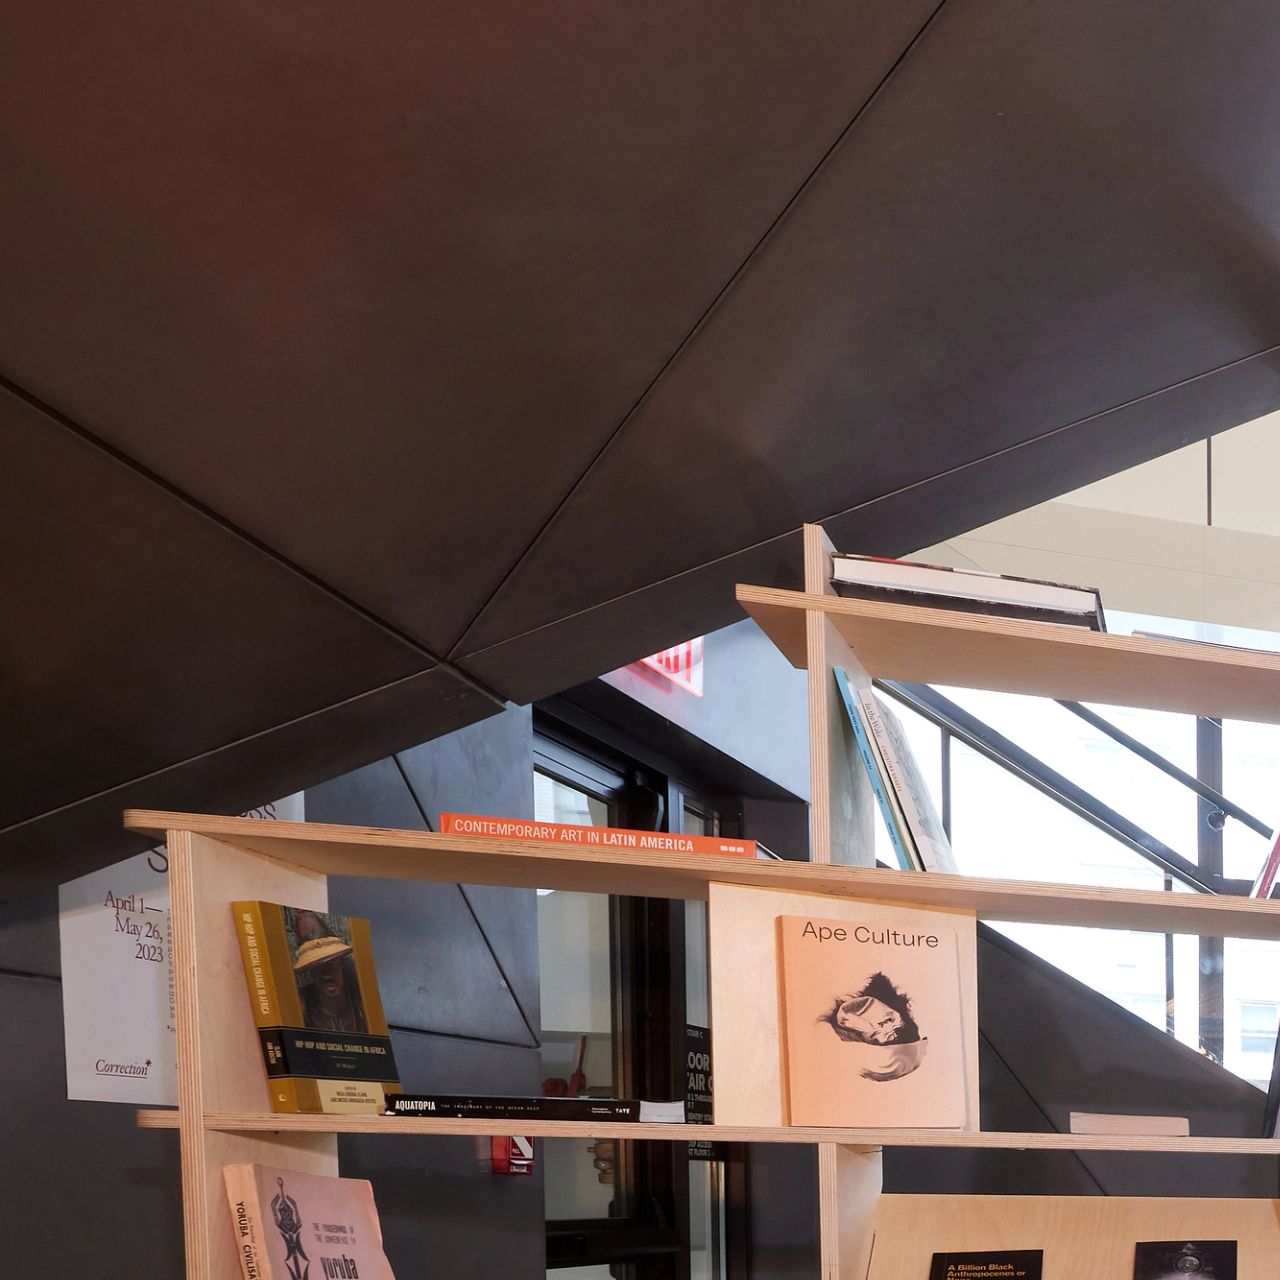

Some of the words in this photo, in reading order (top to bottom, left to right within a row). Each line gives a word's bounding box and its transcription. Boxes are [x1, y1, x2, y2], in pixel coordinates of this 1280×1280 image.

[871, 719, 882, 739] Wake
[454, 818, 557, 841] CONTEMPORARY
[560, 829, 584, 843] ART
[587, 831, 600, 844] IN
[603, 832, 637, 848] LATIN
[640, 836, 694, 852] AMERICA
[104, 891, 135, 915] April
[114, 916, 143, 941] May
[145, 921, 163, 943] 26,
[802, 920, 845, 943] Ape
[854, 925, 939, 949] Culture
[135, 943, 164, 963] 2023
[257, 995, 270, 1015] AFRICA
[395, 1100, 436, 1112] AQUATOPIA
[615, 1106, 631, 1115] TATE
[236, 1200, 249, 1238] YORUBA
[947, 1271, 1017, 1279] Anthropocenes
[988, 1263, 1014, 1271] Black
